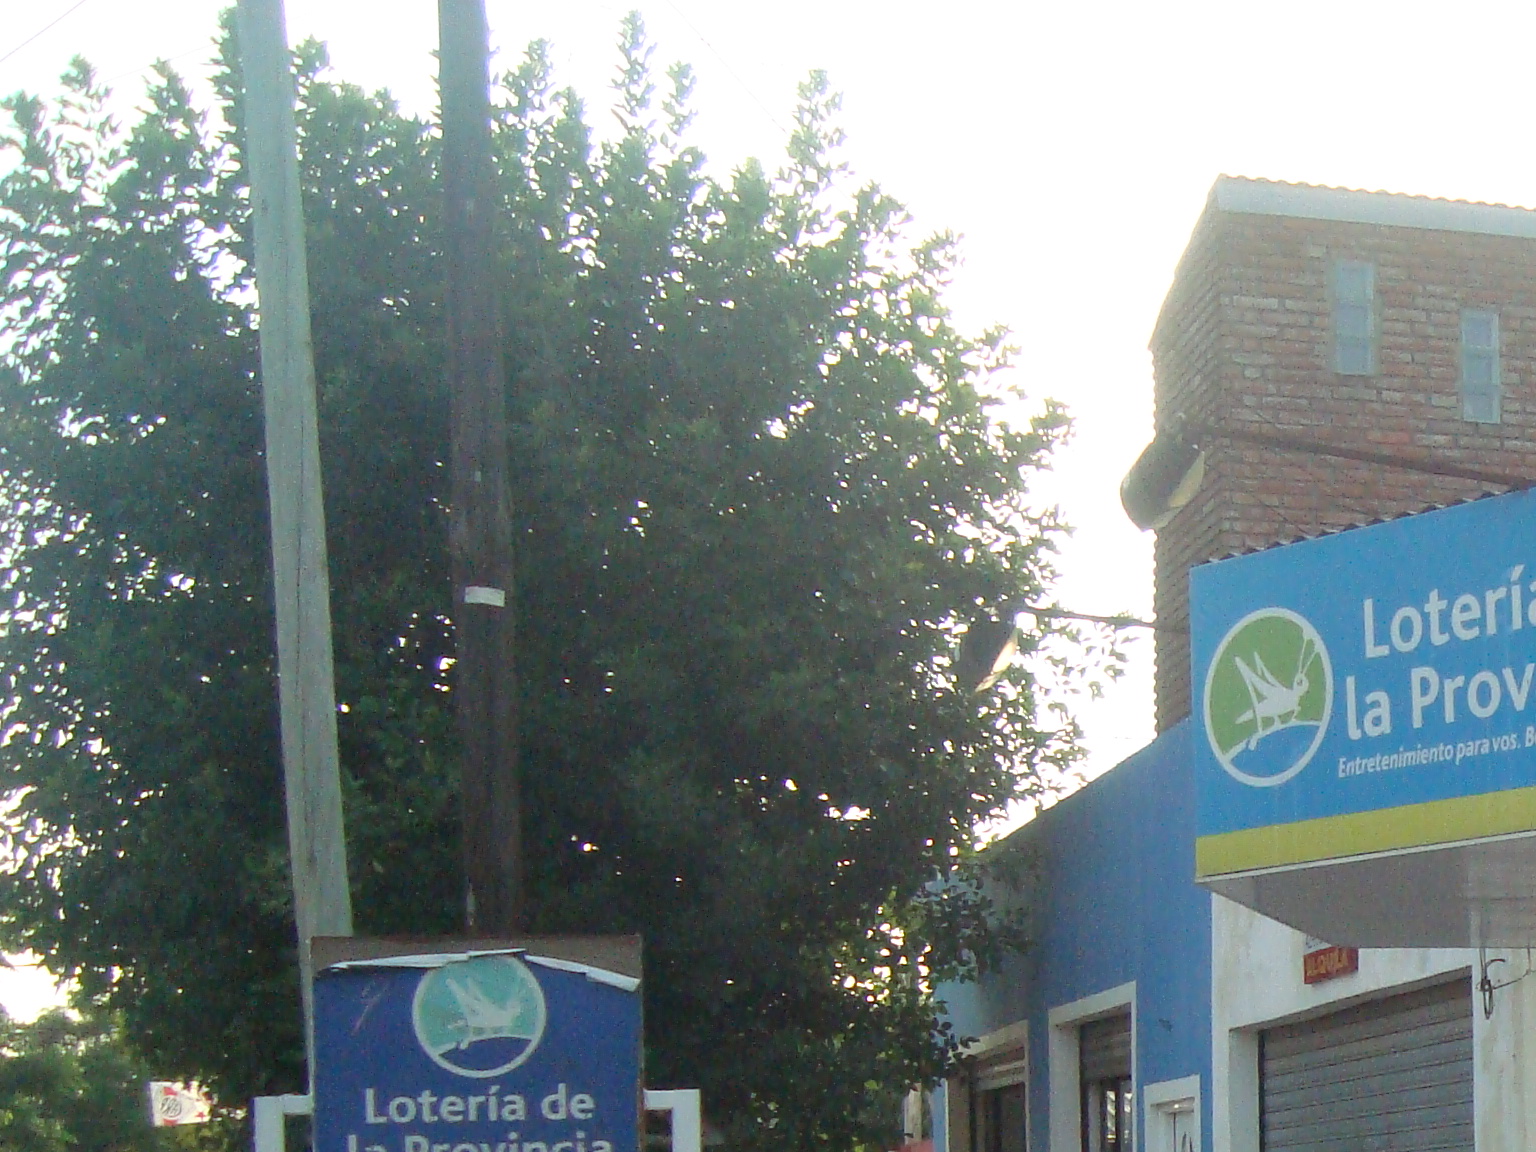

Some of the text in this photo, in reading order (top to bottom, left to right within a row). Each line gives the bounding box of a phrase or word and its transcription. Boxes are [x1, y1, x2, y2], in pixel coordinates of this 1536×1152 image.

[1345, 675, 1392, 740] la
[1338, 742, 1454, 779] Entretenimiento
[1455, 737, 1490, 766] para
[1493, 733, 1521, 753] vos.
[364, 1082, 596, 1125] Lotería de
